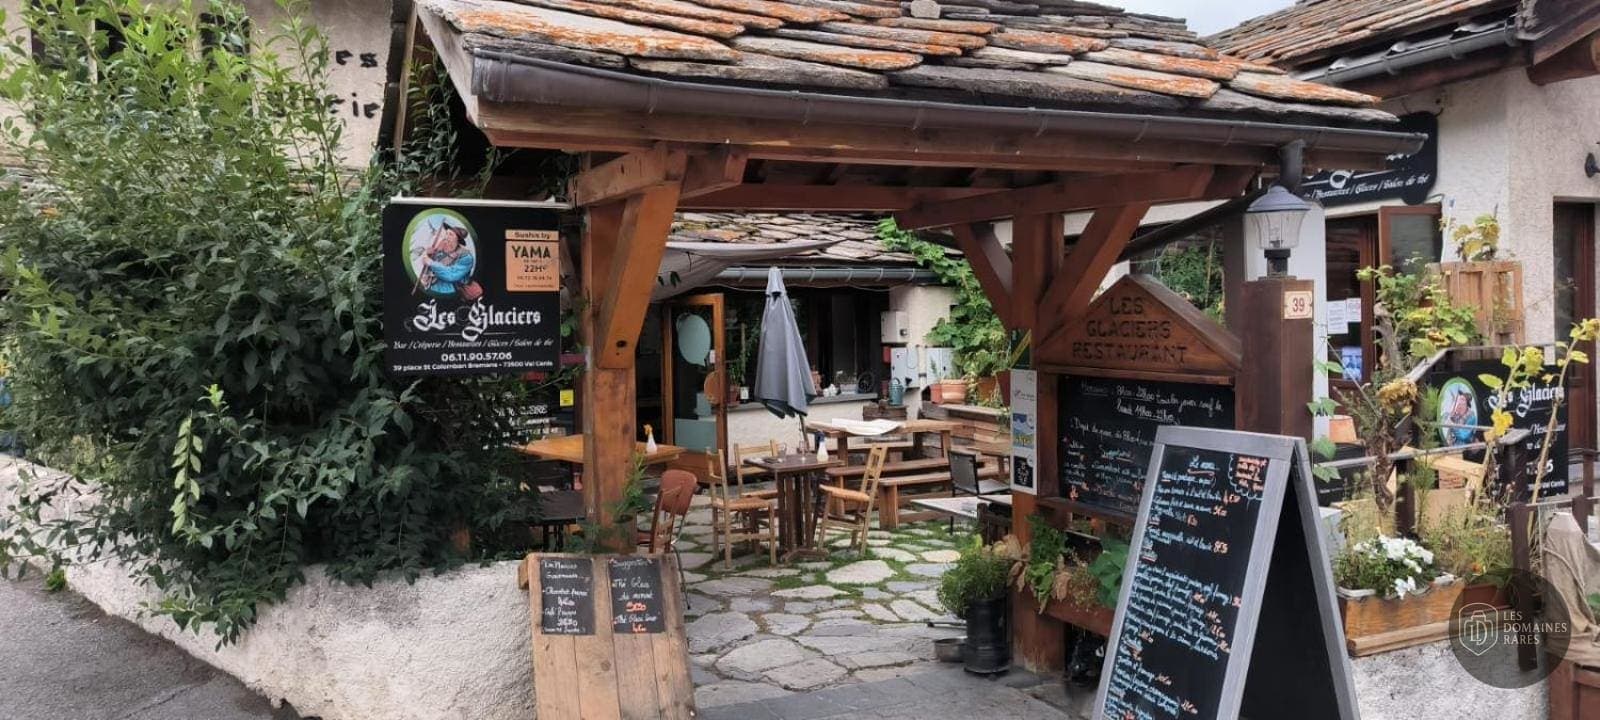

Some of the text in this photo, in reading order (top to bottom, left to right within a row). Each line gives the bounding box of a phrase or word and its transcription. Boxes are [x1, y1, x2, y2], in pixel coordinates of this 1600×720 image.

[540, 231, 550, 240] by
[511, 245, 553, 258] YAMA
[1110, 296, 1144, 316] LES
[1292, 296, 1306, 313] 39
[412, 297, 542, 341] Les Glaciers
[1086, 319, 1172, 340] GLACIERS
[440, 352, 512, 362] 06.11.90.57.06
[1072, 341, 1188, 365] RESTAURANT
